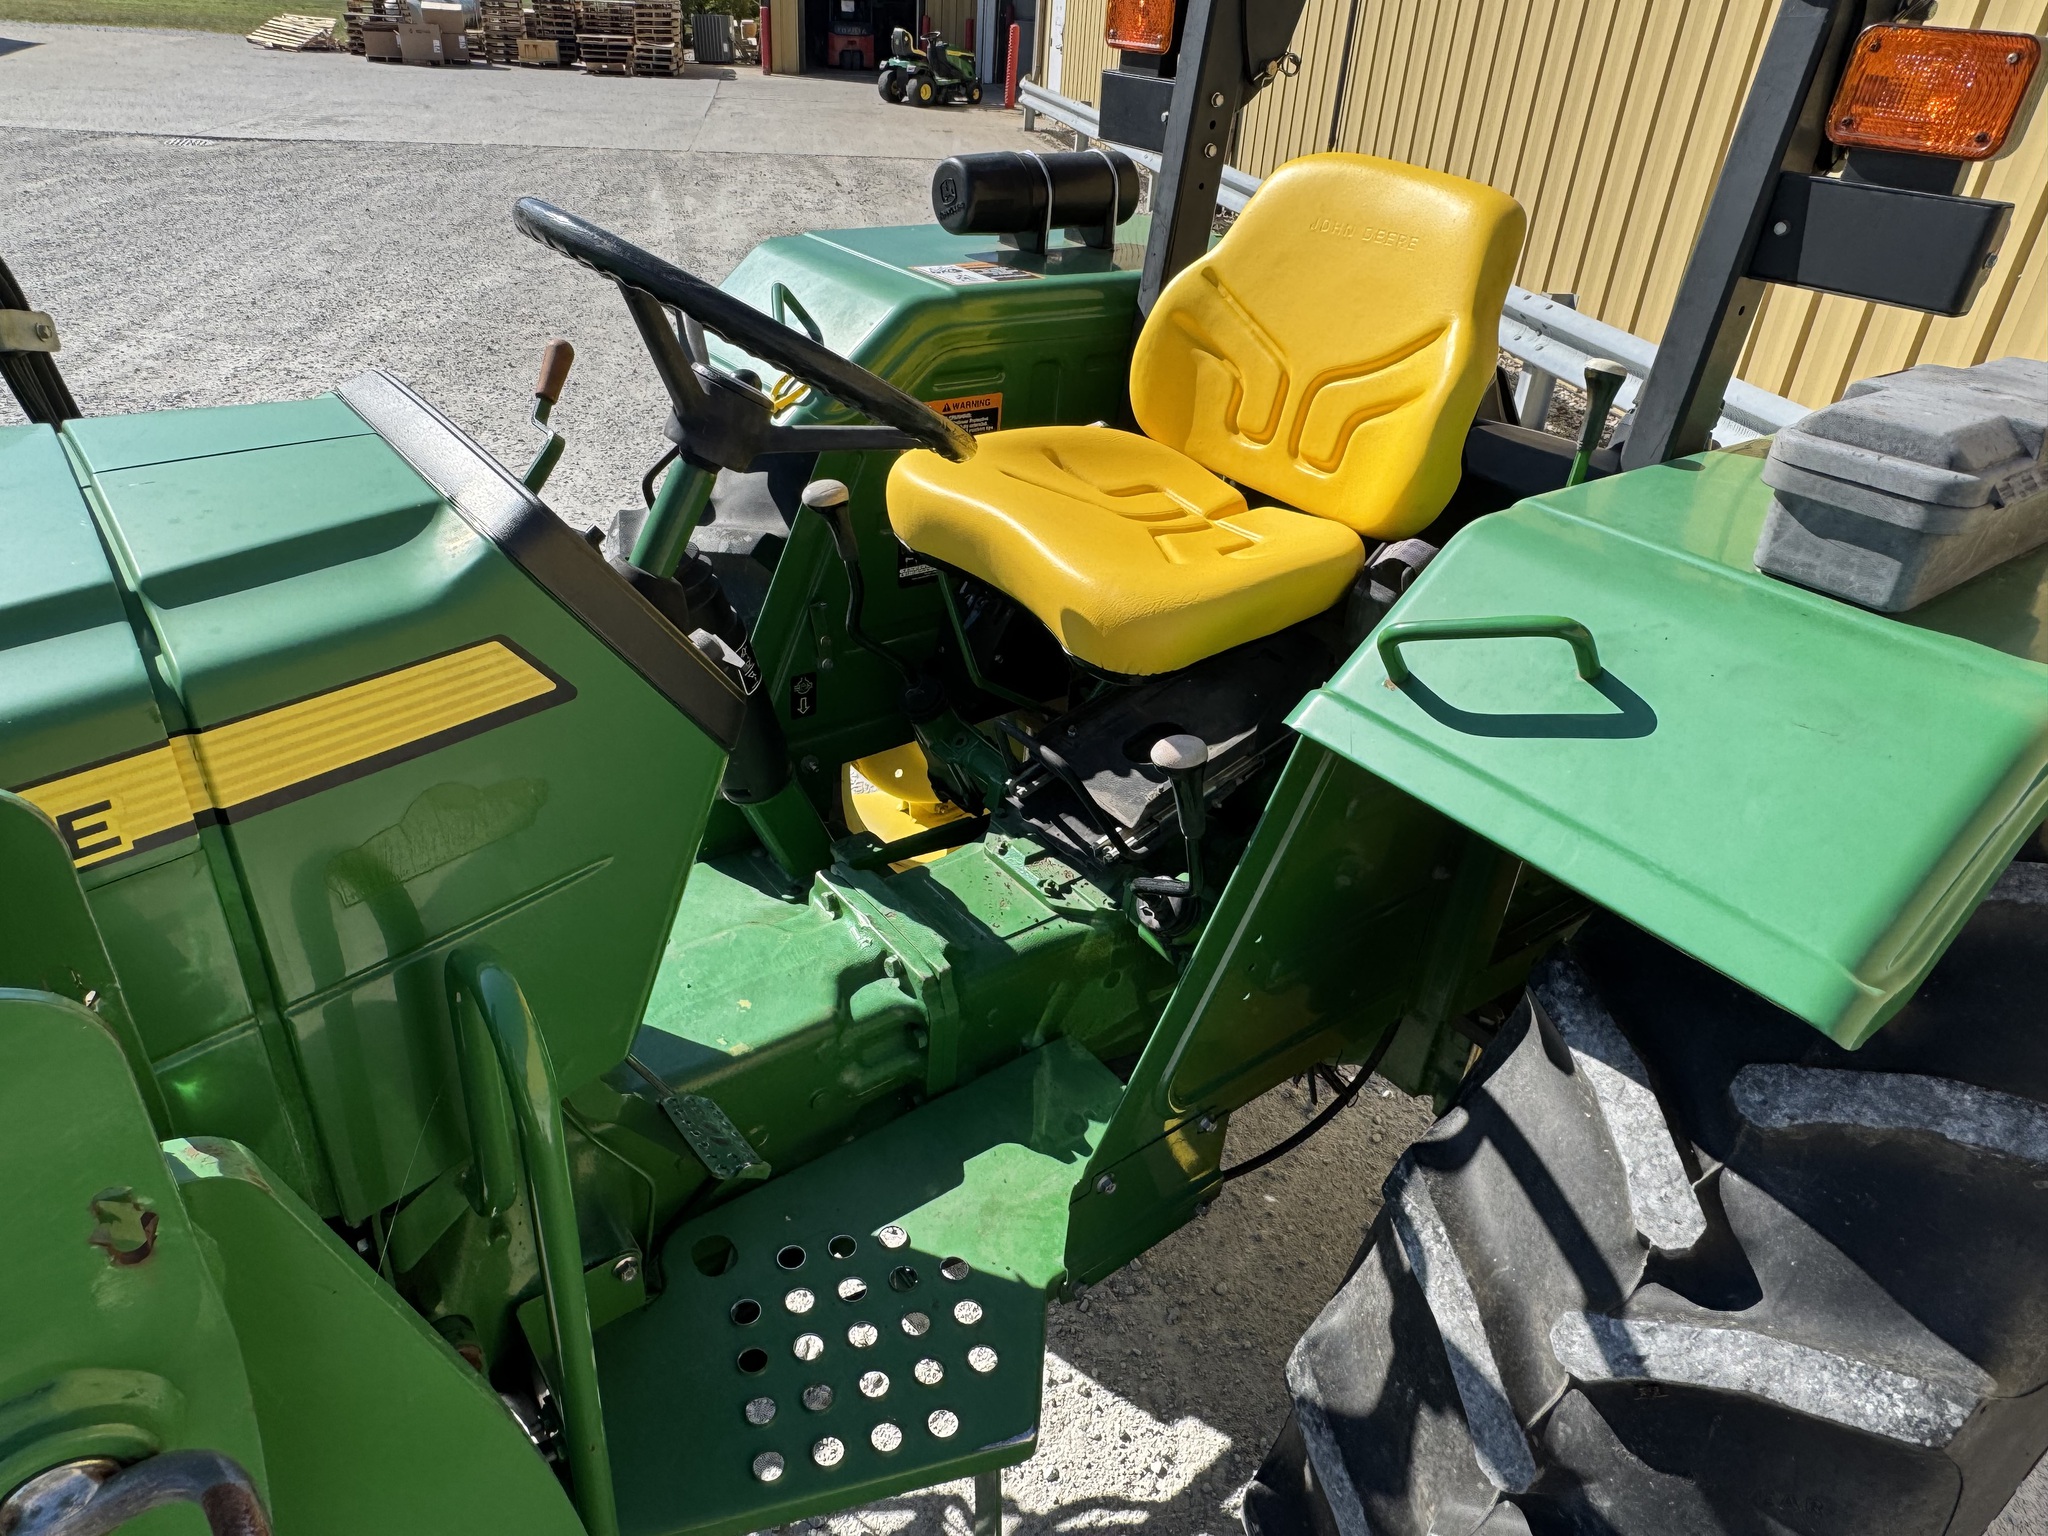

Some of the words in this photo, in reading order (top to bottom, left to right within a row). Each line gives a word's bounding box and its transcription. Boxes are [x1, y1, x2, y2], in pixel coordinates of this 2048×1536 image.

[1309, 217, 1357, 238] JOHN
[1361, 226, 1419, 251] DEERE
[952, 398, 991, 411] WARNING
[56, 799, 122, 860] E
